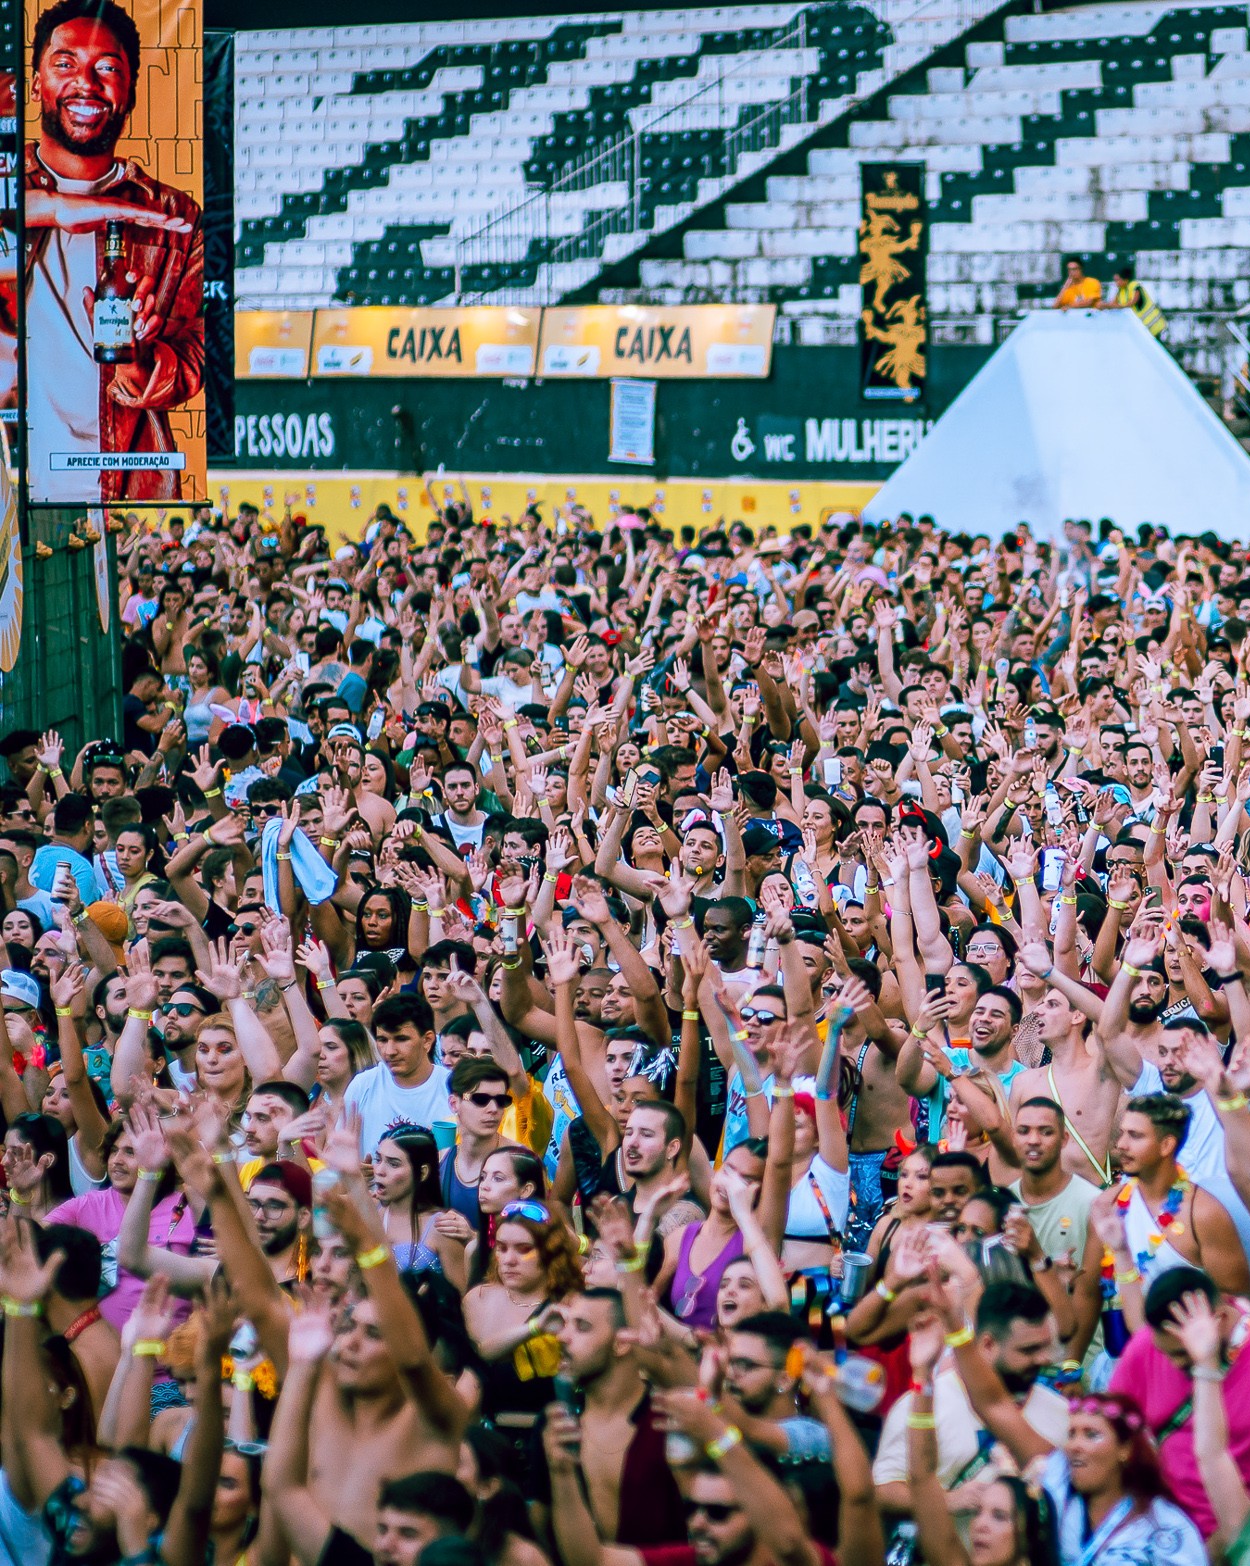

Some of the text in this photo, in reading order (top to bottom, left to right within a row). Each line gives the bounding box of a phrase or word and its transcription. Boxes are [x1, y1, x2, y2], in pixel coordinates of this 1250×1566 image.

[386, 327, 463, 364] CAIXA
[614, 325, 693, 365] CAIXA
[234, 412, 336, 459] PESSOAS
[763, 433, 796, 462] WC
[66, 455, 170, 468] APRECIE COM MODERAÇÃO
